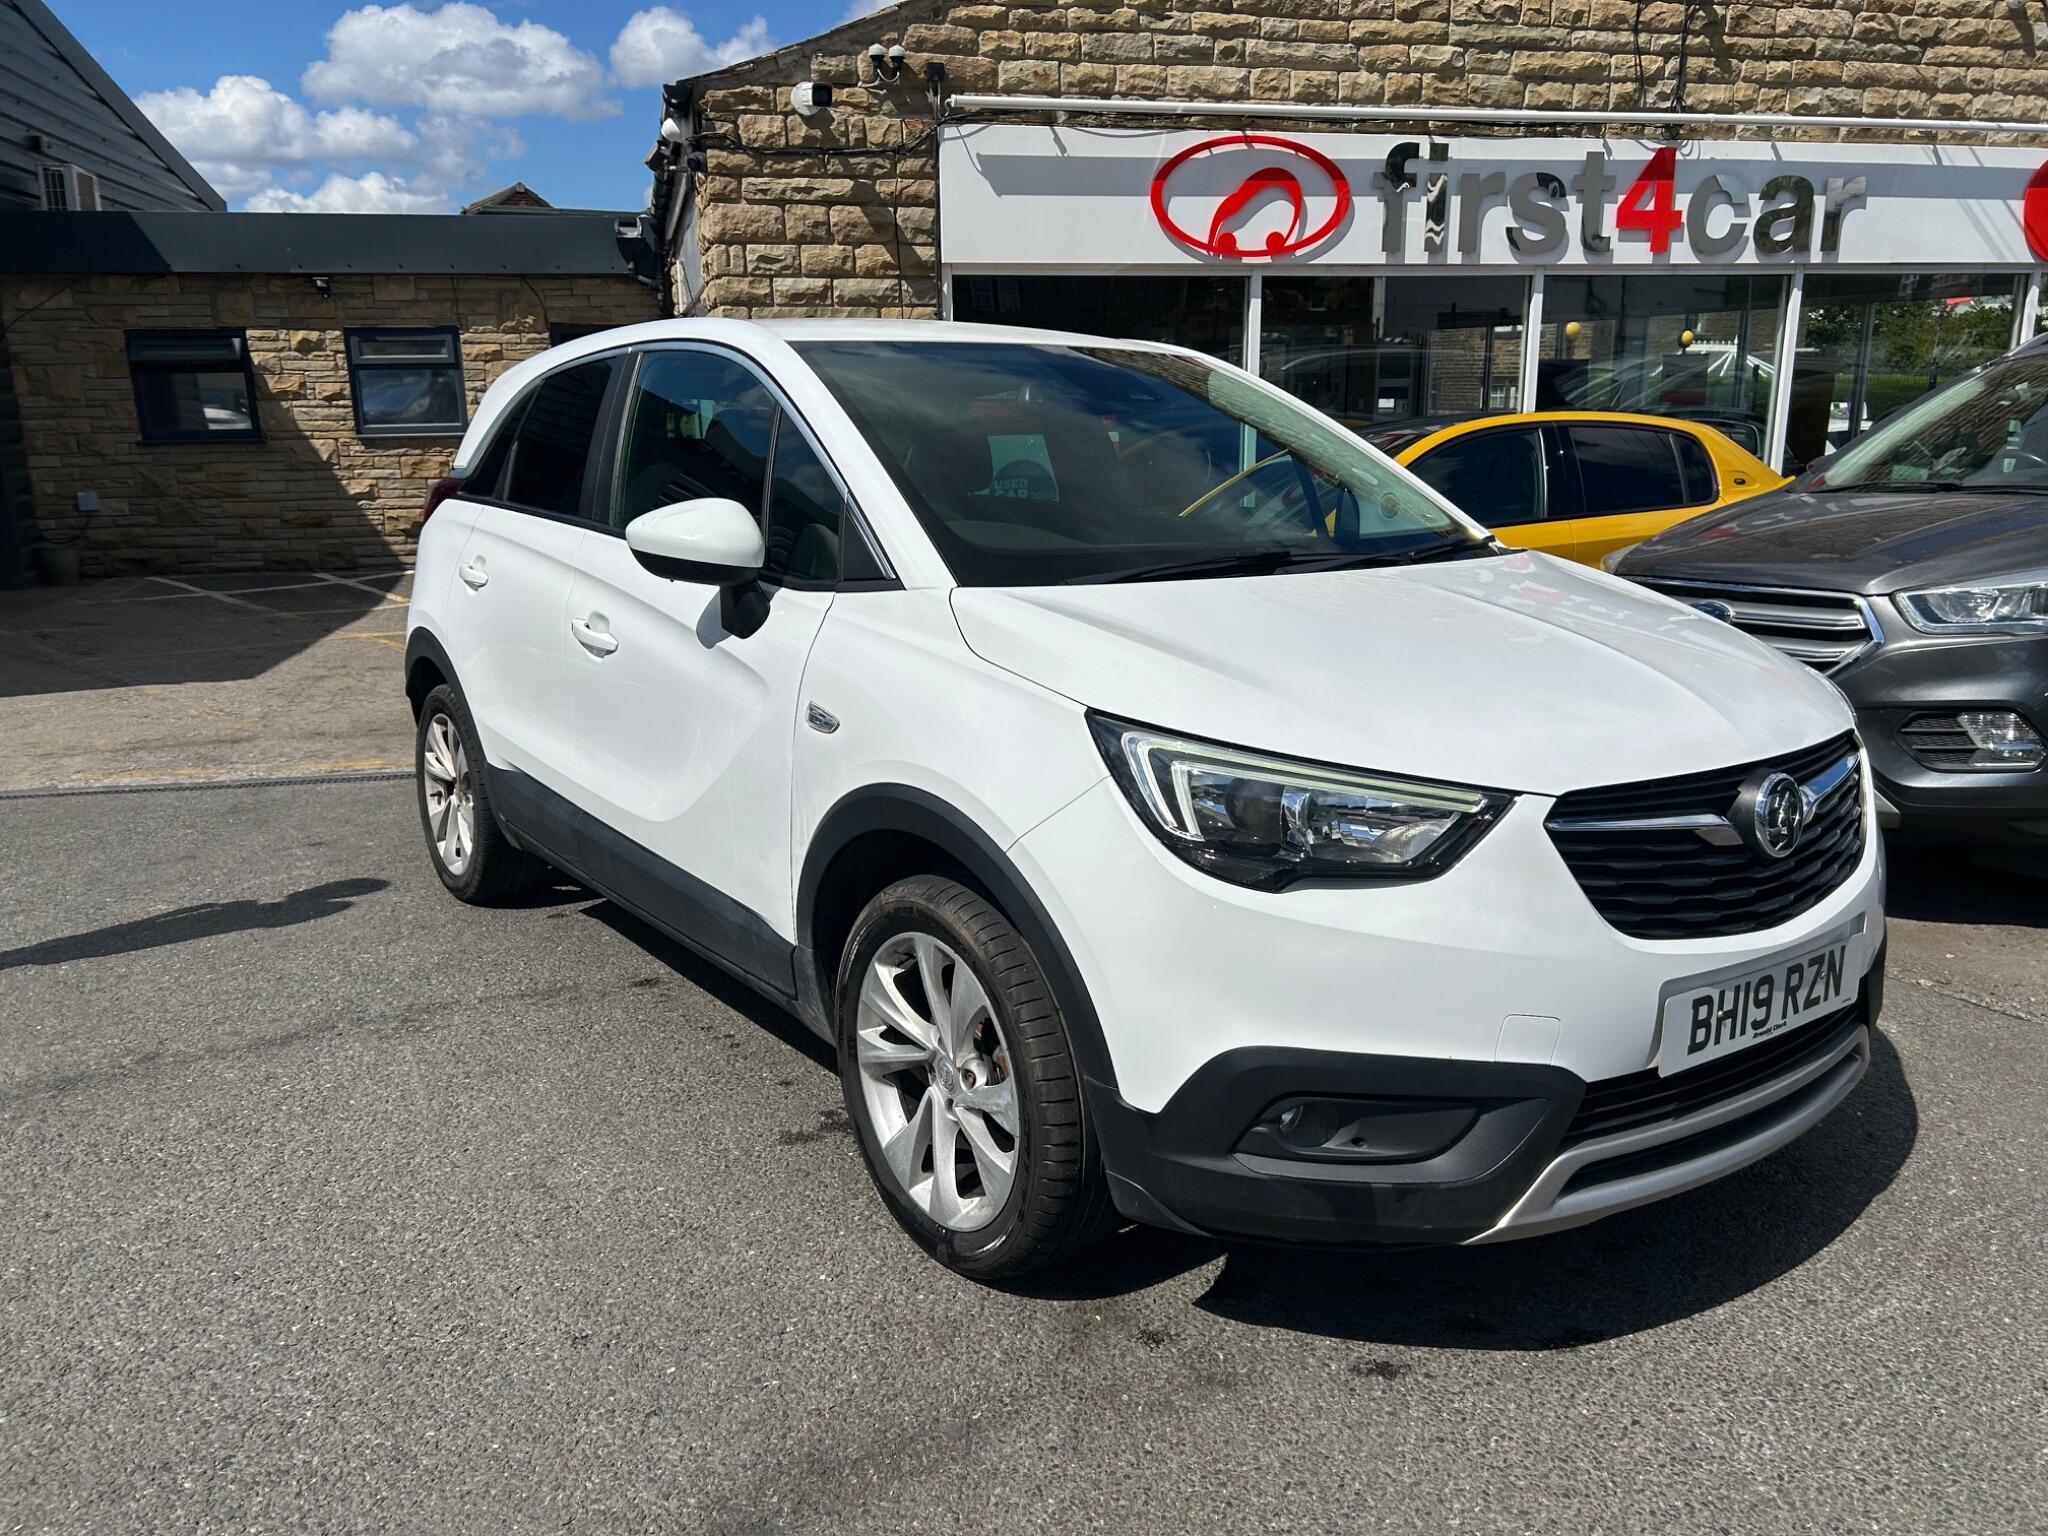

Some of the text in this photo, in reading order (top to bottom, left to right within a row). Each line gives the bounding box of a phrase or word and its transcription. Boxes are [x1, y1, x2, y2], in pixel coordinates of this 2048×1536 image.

[1373, 142, 1867, 254] first4car
[994, 478, 1028, 489] USED
[1687, 945, 1846, 1056] BH19 RZN
